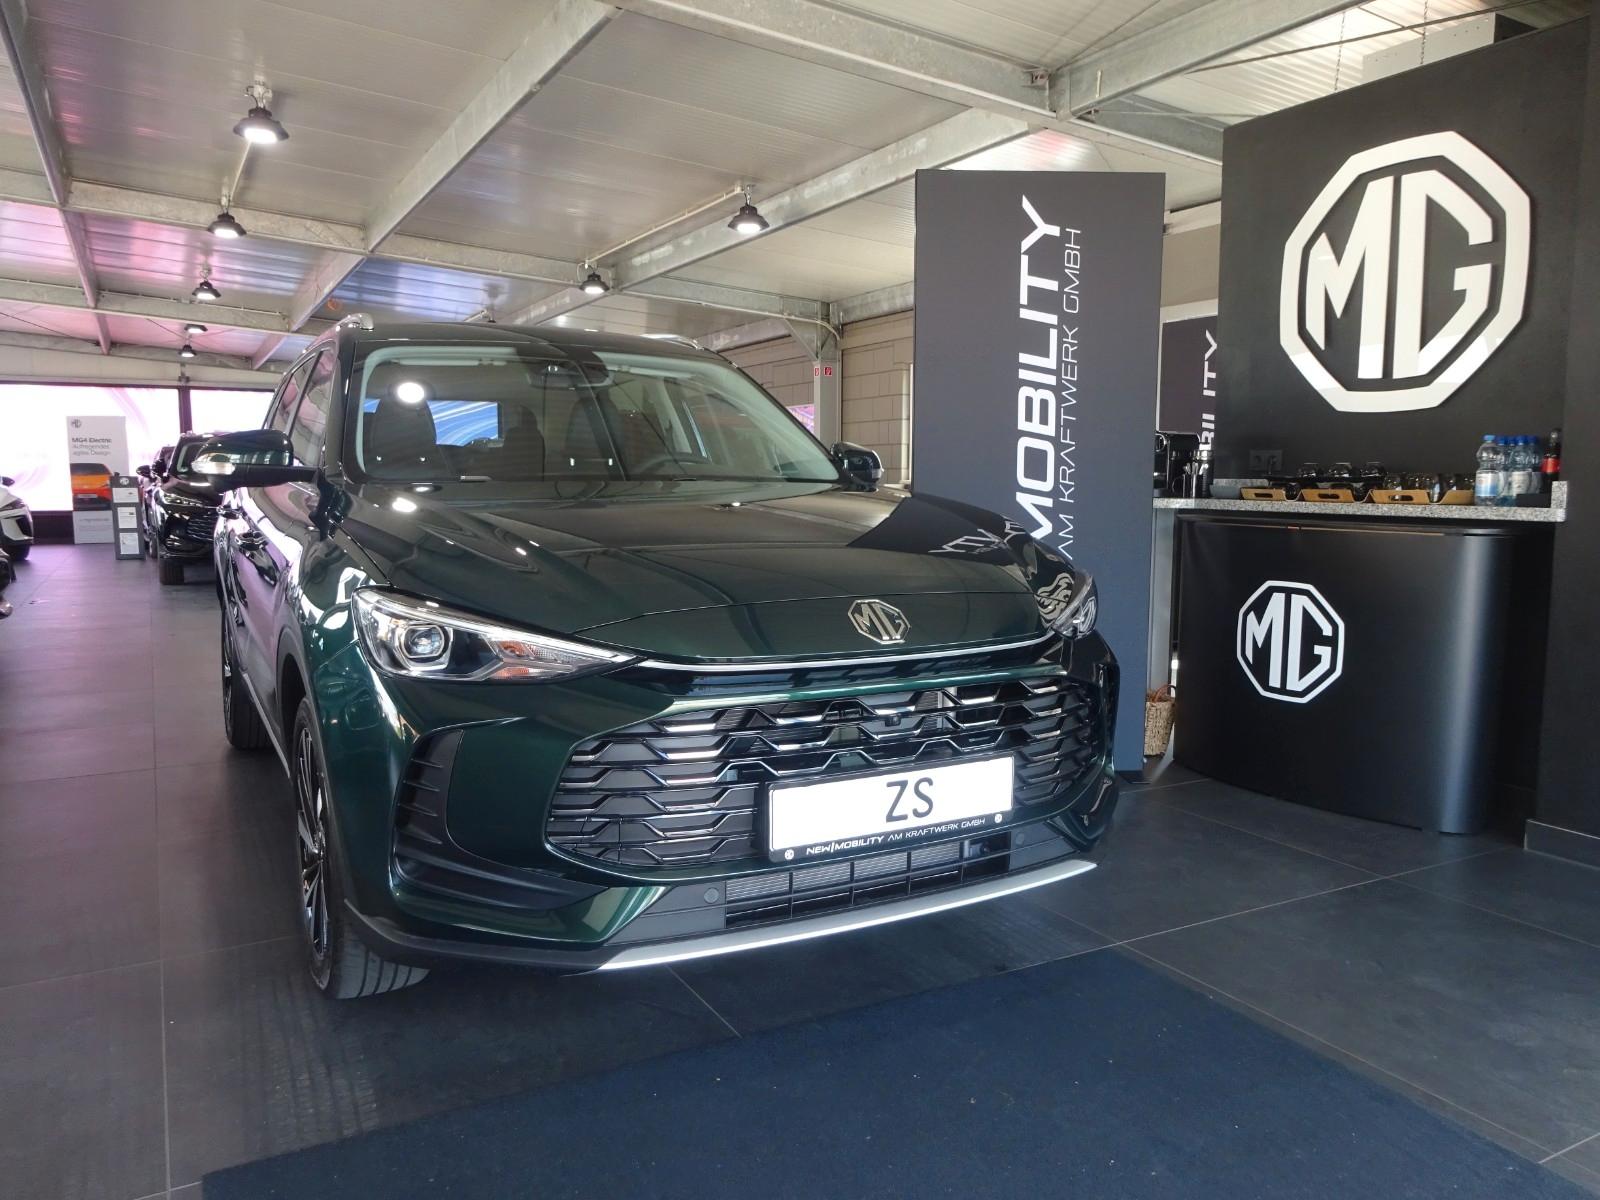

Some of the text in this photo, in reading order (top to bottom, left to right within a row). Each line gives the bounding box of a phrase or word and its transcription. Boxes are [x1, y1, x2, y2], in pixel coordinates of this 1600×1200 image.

[1304, 168, 1493, 381] MG
[1015, 193, 1061, 540] MOBILITY
[1057, 227, 1081, 561] AM KRAFTWERK GMBH
[852, 602, 907, 641] MG
[1244, 591, 1334, 693] MG
[885, 776, 935, 824] ZS
[887, 832, 903, 842] AM
[905, 822, 959, 839] KRAFTWERK
[960, 817, 986, 829] GMBH
